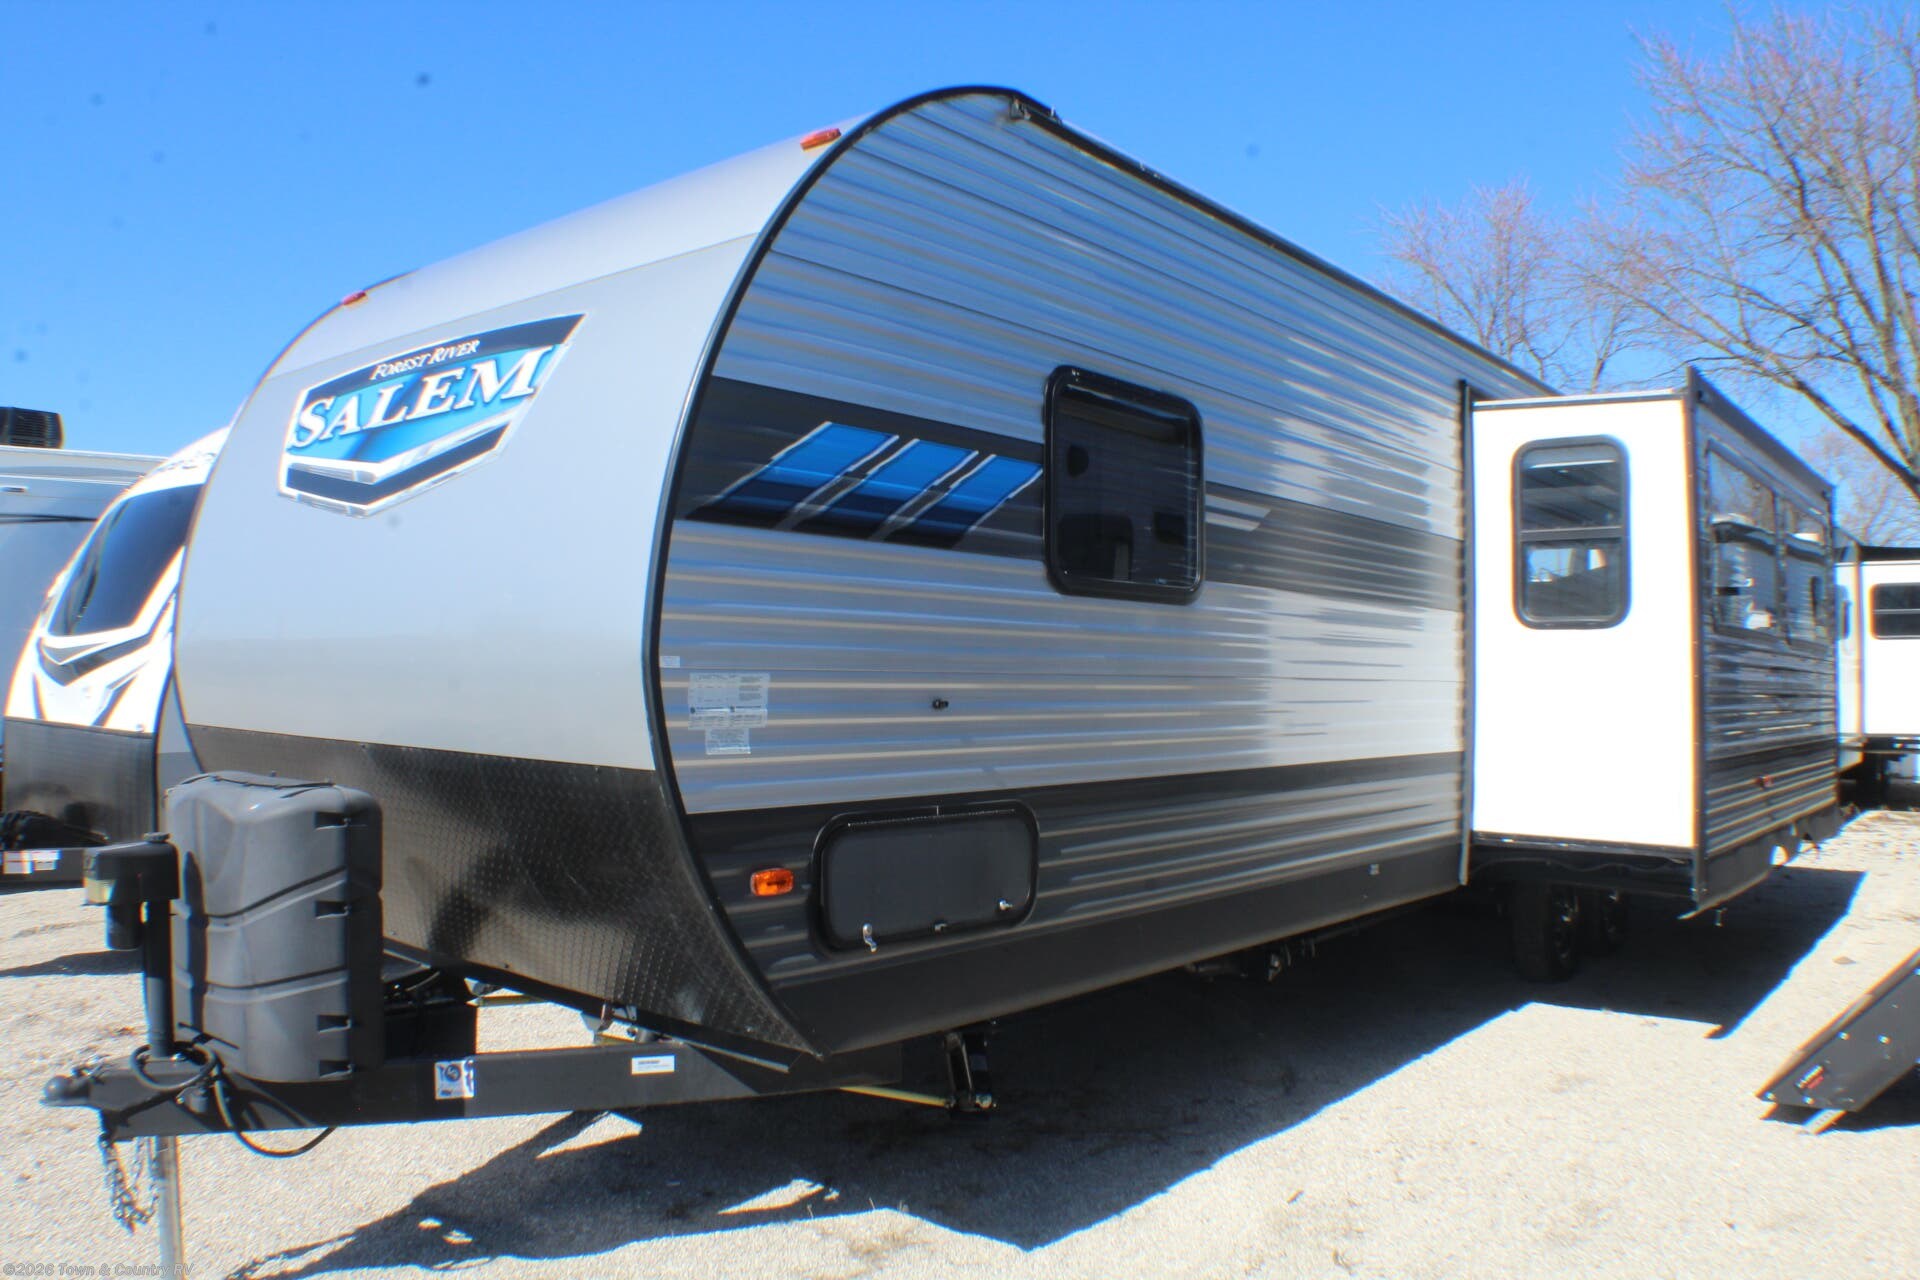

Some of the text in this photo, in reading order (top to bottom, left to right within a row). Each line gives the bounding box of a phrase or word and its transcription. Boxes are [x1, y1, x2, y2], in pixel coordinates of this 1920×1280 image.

[370, 340, 480, 380] FOREST RIVER
[287, 345, 553, 451] SALEM
